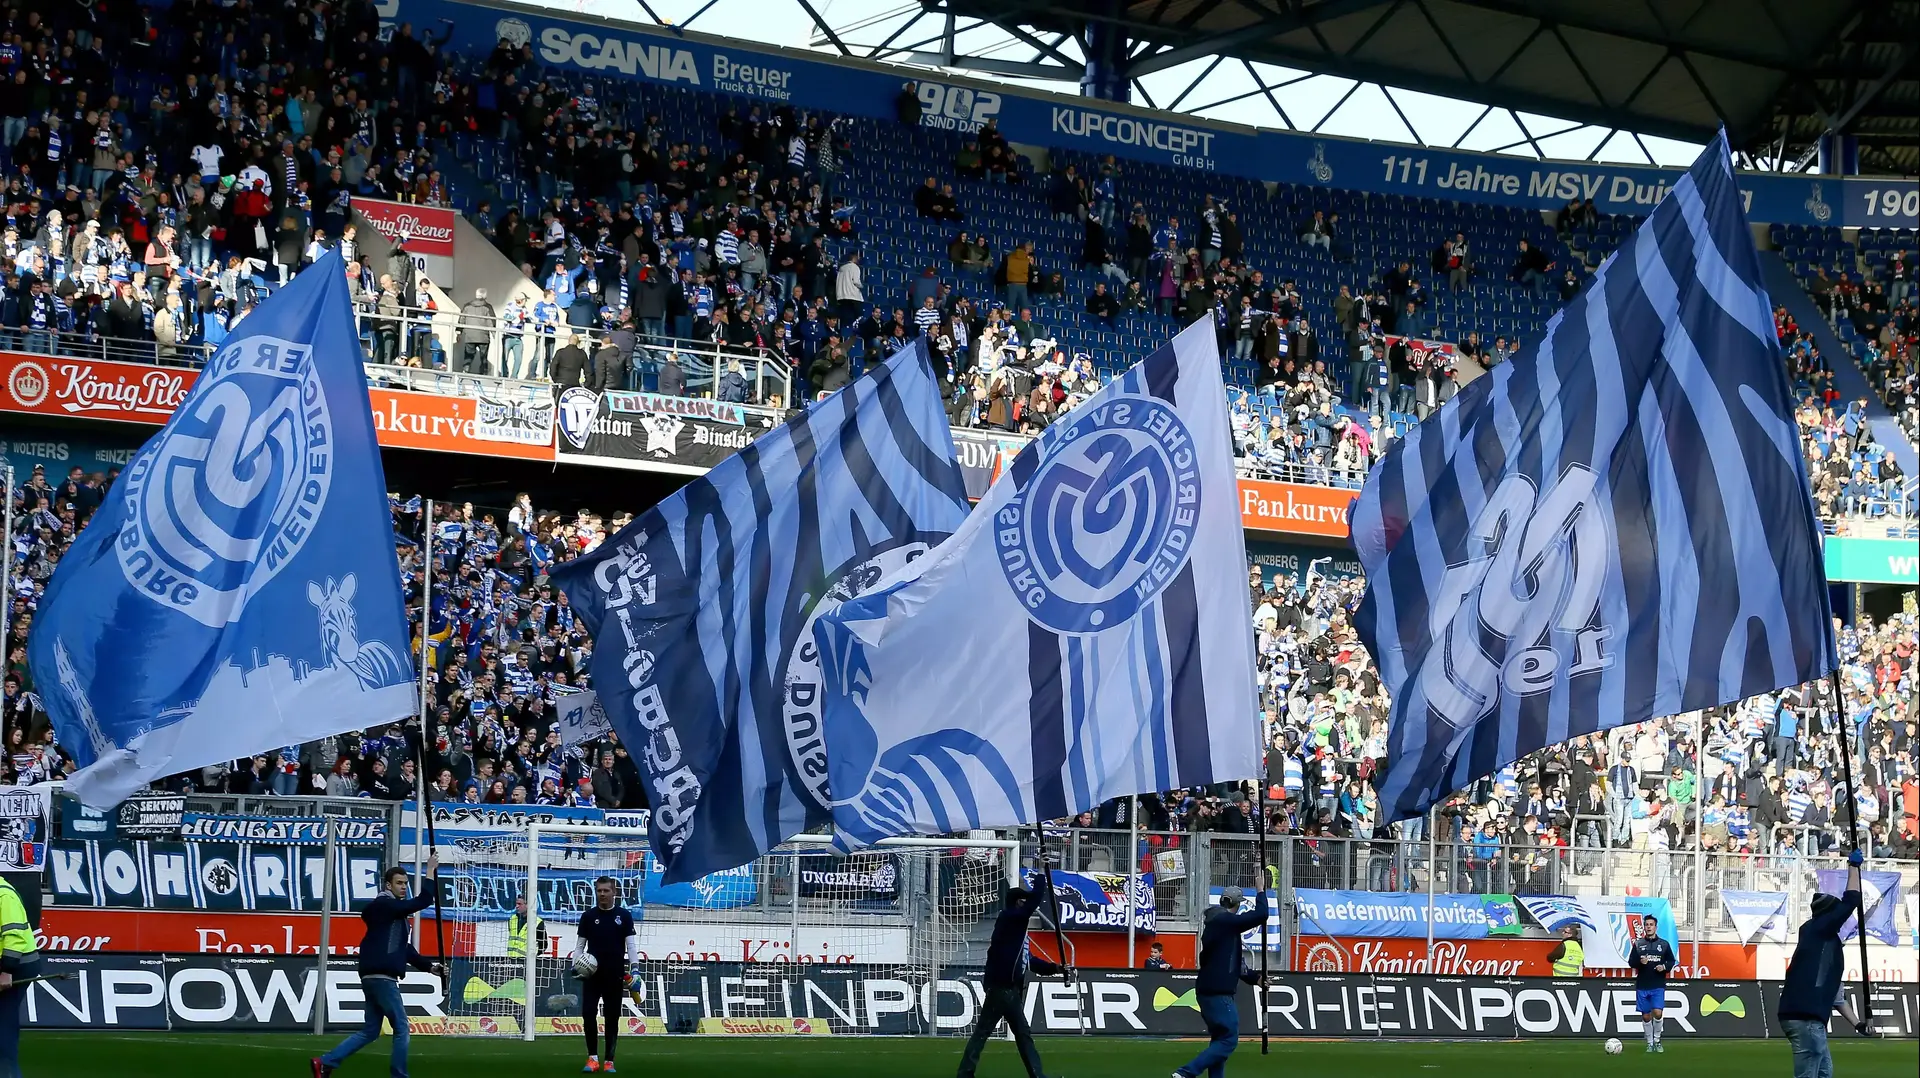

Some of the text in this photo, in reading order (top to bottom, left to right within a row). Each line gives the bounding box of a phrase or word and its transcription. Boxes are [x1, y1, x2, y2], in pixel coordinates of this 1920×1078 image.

[539, 28, 700, 85] SCANIA
[713, 54, 791, 88] Breuer
[713, 77, 791, 100] Truck & Trailer
[925, 114, 956, 131] SIND
[1053, 107, 1215, 156] KUPCONCEPT
[1173, 153, 1215, 171] GMBH
[1383, 155, 1429, 185] 111
[1437, 162, 1520, 196] Jahre
[1528, 171, 1606, 200] MSV
[395, 213, 453, 239] Pilsener
[55, 364, 140, 411] König
[13, 442, 69, 461] WOLTERS
[1242, 489, 1348, 525] Fankurve
[1254, 554, 1299, 570] DANZBERG
[140, 799, 184, 812] SEKTION
[21, 841, 44, 865] RB
[1324, 900, 1417, 922] aeternum
